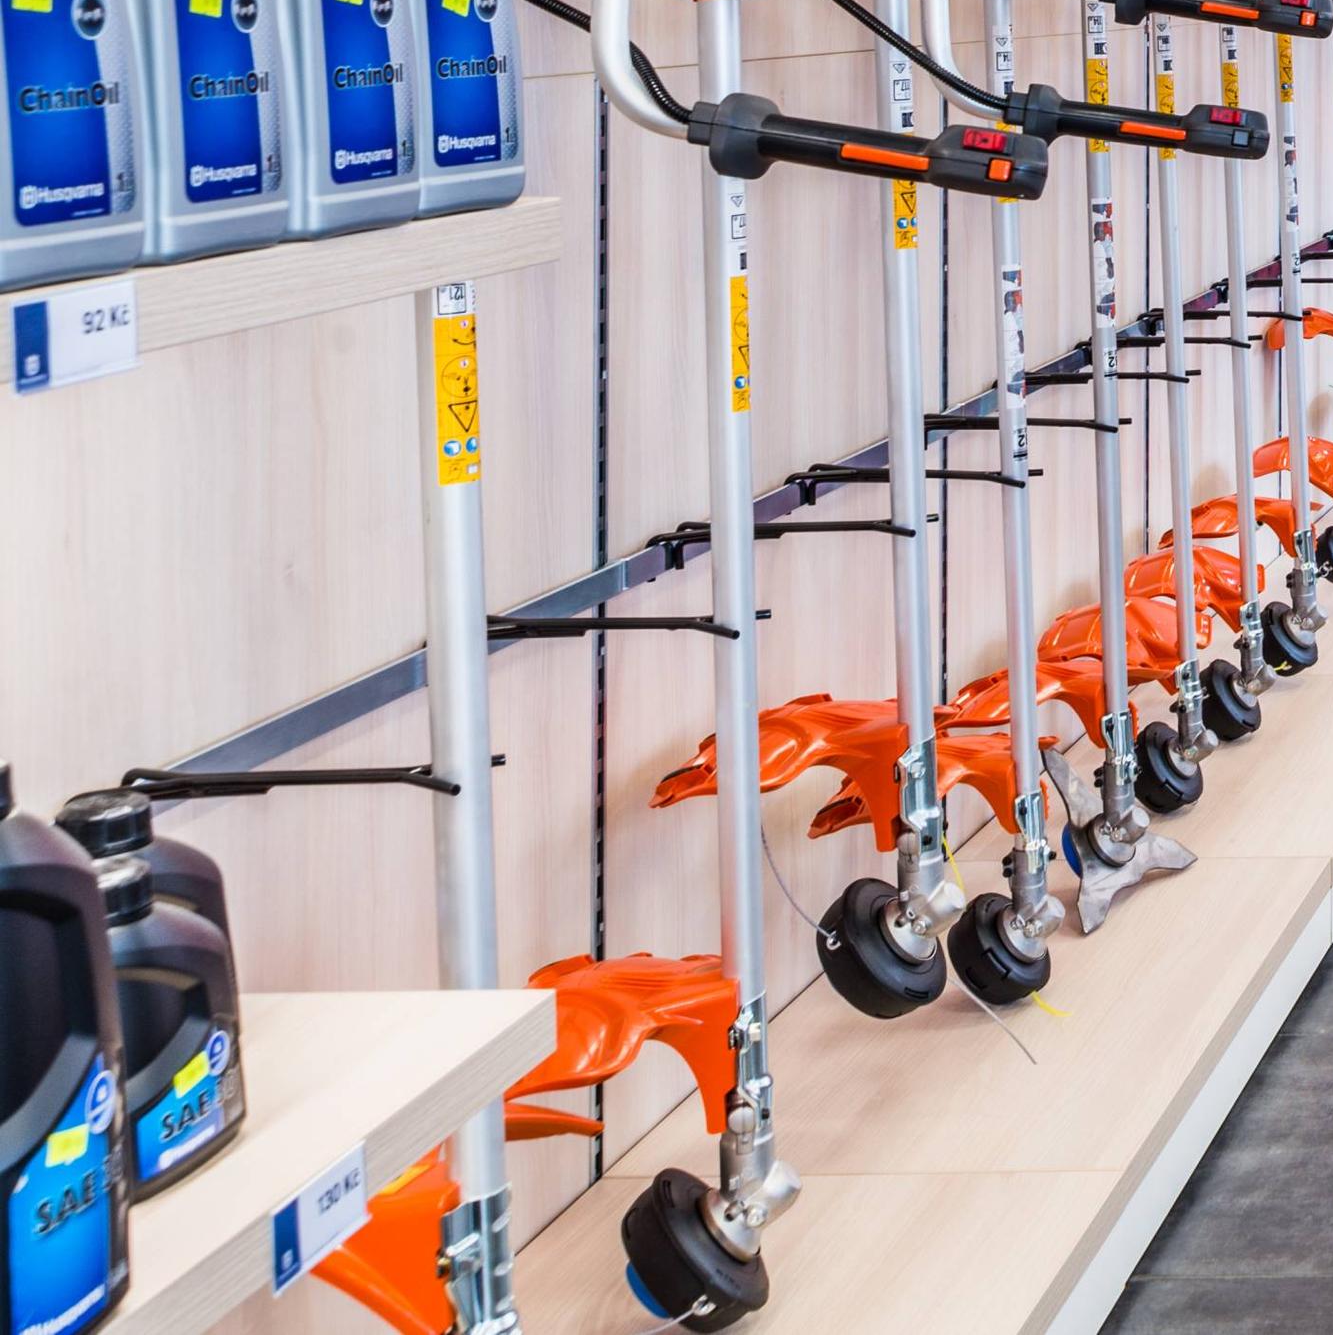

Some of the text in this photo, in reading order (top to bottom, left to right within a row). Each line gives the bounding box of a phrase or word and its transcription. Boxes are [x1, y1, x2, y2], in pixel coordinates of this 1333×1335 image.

[333, 63, 403, 89] ChainOil
[436, 55, 507, 79] ChainOil
[189, 71, 269, 100] ChainOil
[19, 82, 120, 114] ChainOil
[449, 134, 496, 151] Husqvarna
[346, 148, 393, 165] Husqvarna
[203, 164, 257, 183] Husqvarna
[37, 182, 104, 204] Husqvarna
[83, 310, 105, 334] 92
[160, 1088, 211, 1141] SAE
[36, 1167, 99, 1235] SAE
